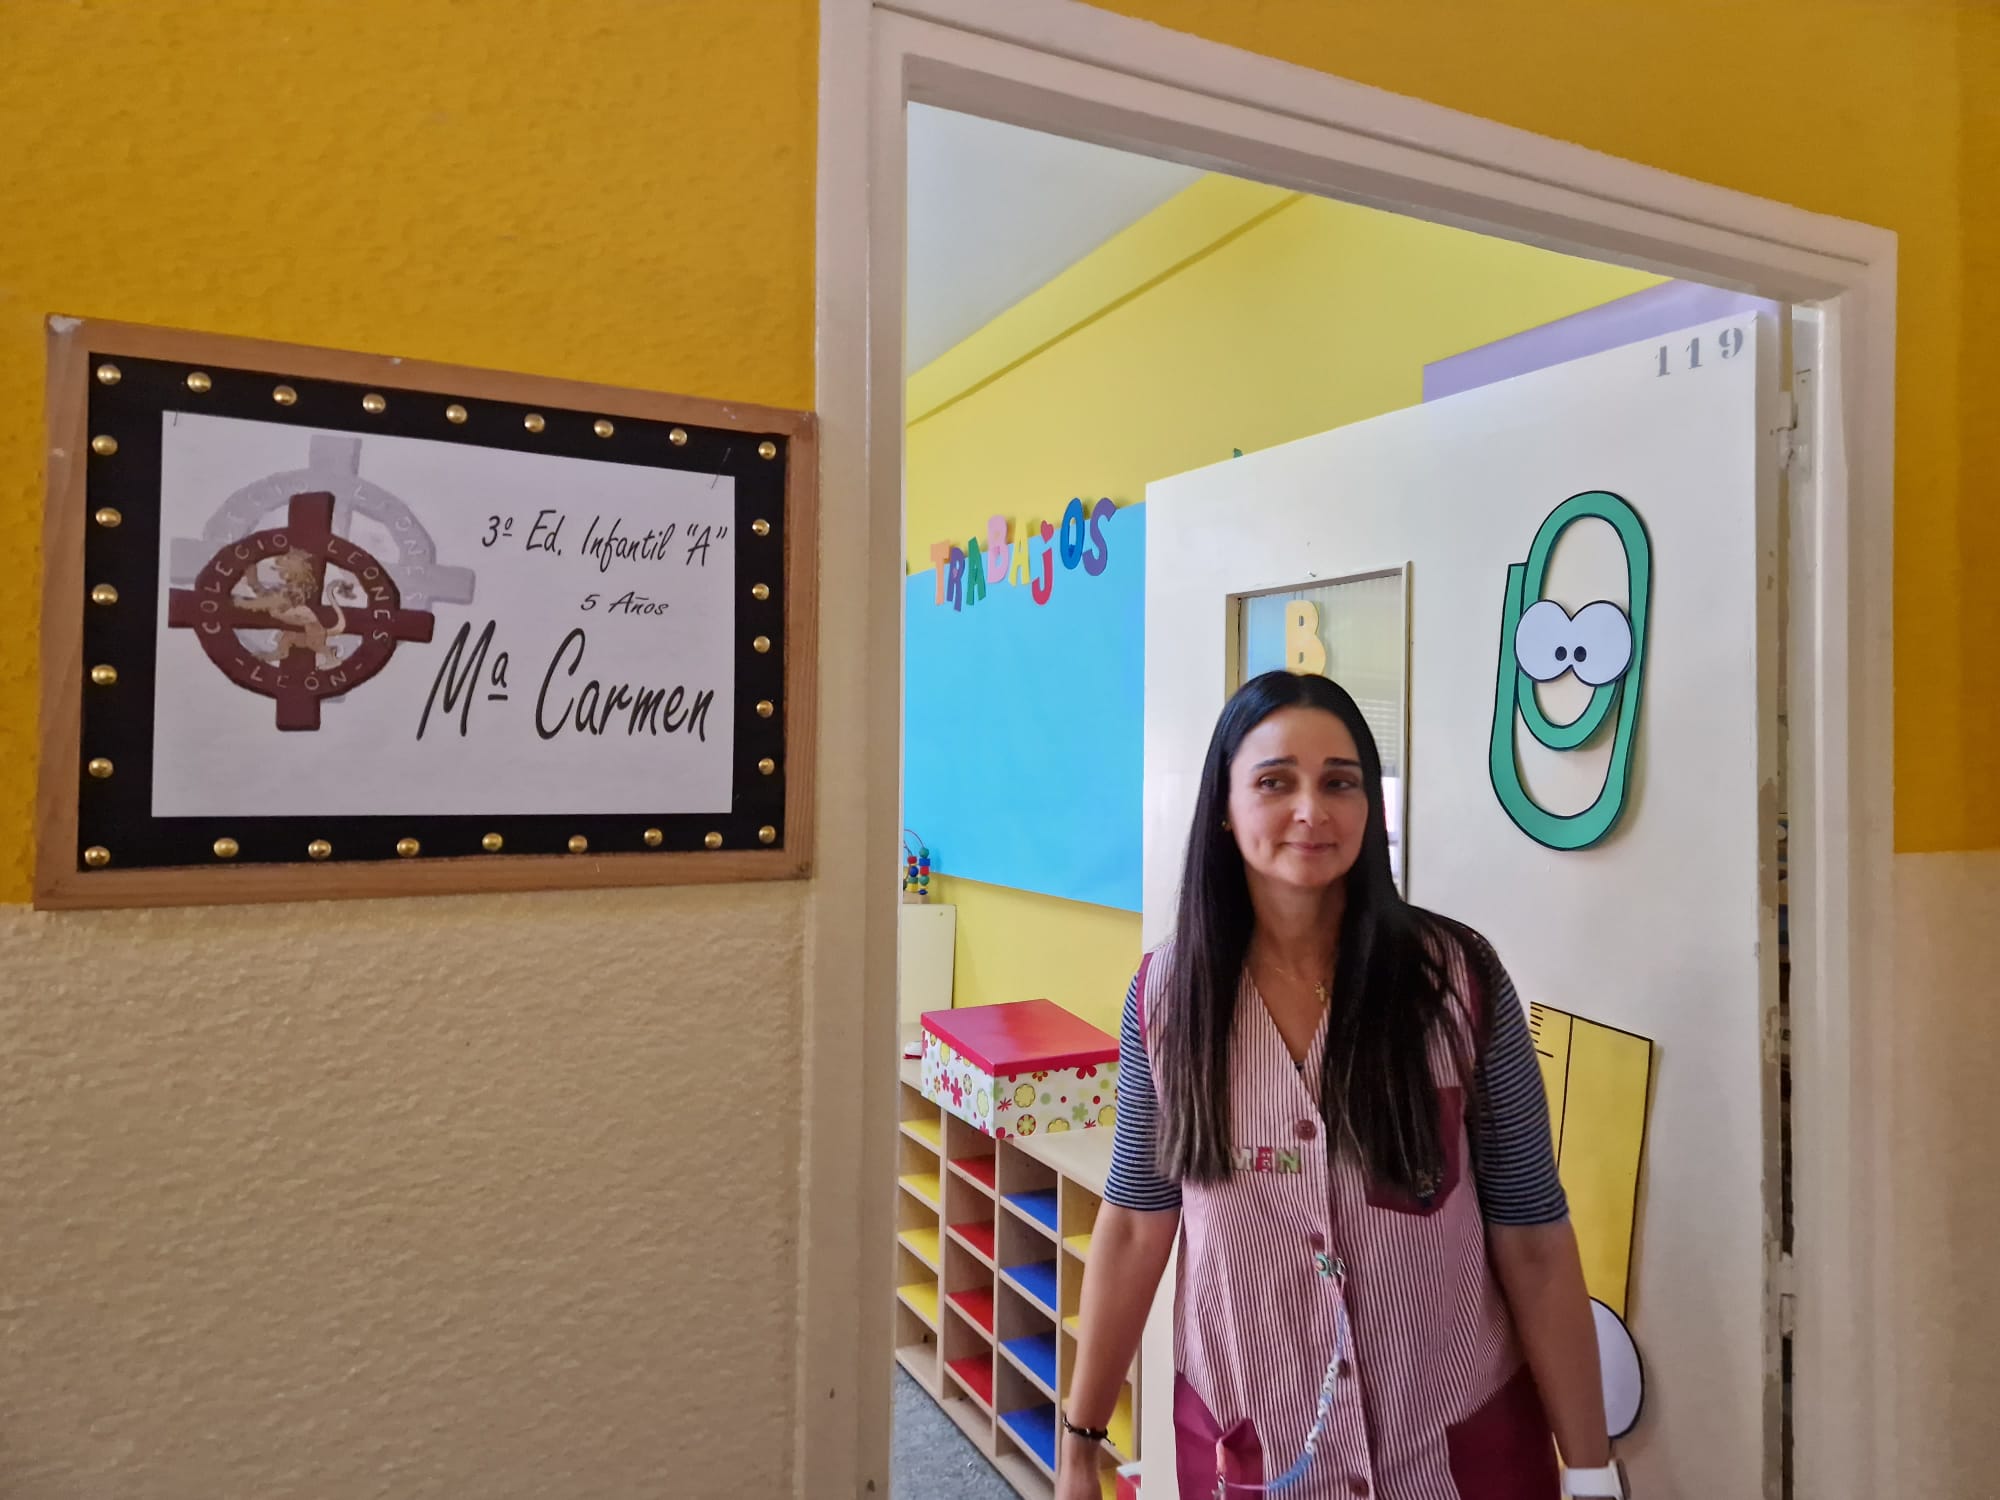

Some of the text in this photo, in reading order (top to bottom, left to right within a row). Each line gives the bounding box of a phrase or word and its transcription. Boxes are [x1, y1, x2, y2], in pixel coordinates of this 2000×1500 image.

[1654, 327, 1744, 377] 119
[526, 509, 566, 556] Ed.
[581, 514, 676, 573] Infantil
[200, 534, 288, 635] COLEGIO
[580, 590, 670, 616] 5 Años
[1285, 600, 1326, 677] B
[416, 619, 714, 742] Mª Carmen
